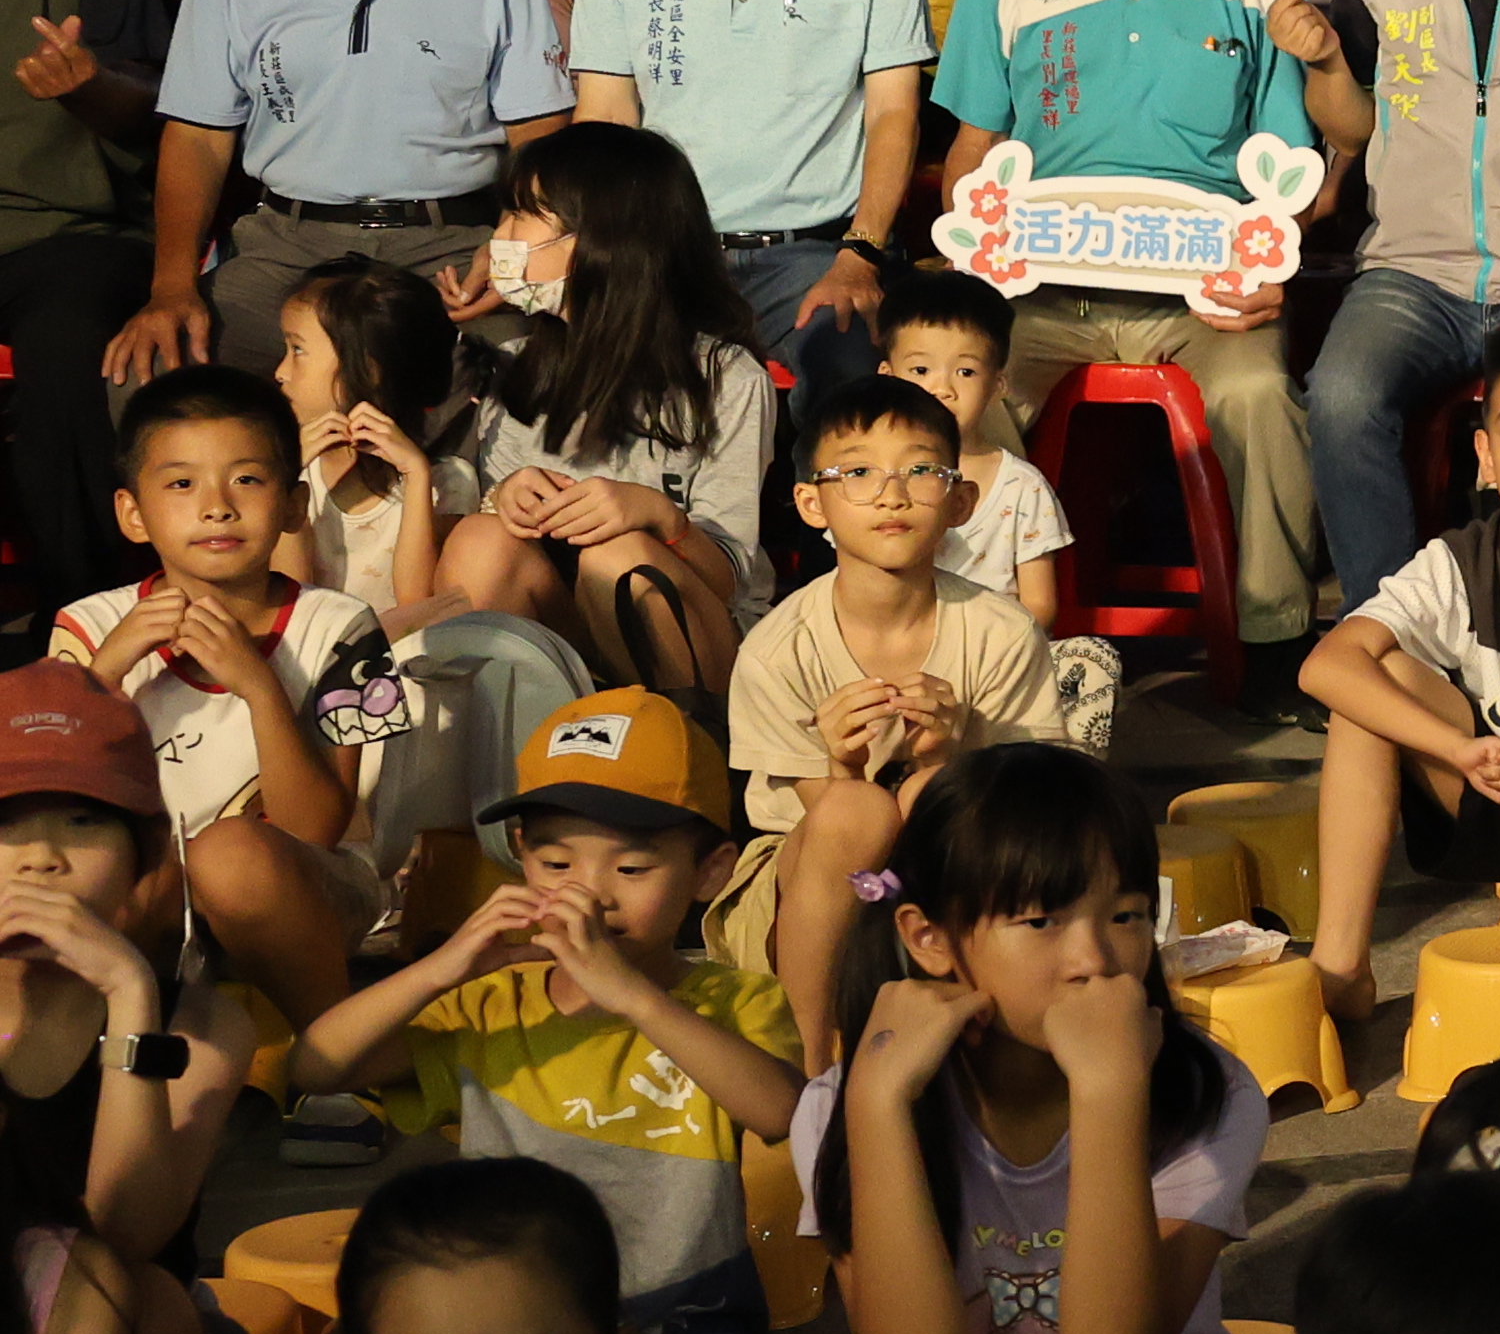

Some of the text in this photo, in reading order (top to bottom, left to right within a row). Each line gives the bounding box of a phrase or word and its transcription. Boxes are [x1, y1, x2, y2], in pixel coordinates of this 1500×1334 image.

[1419, 3, 1439, 73] 副區長
[1013, 206, 1225, 264] 活力滿滿
